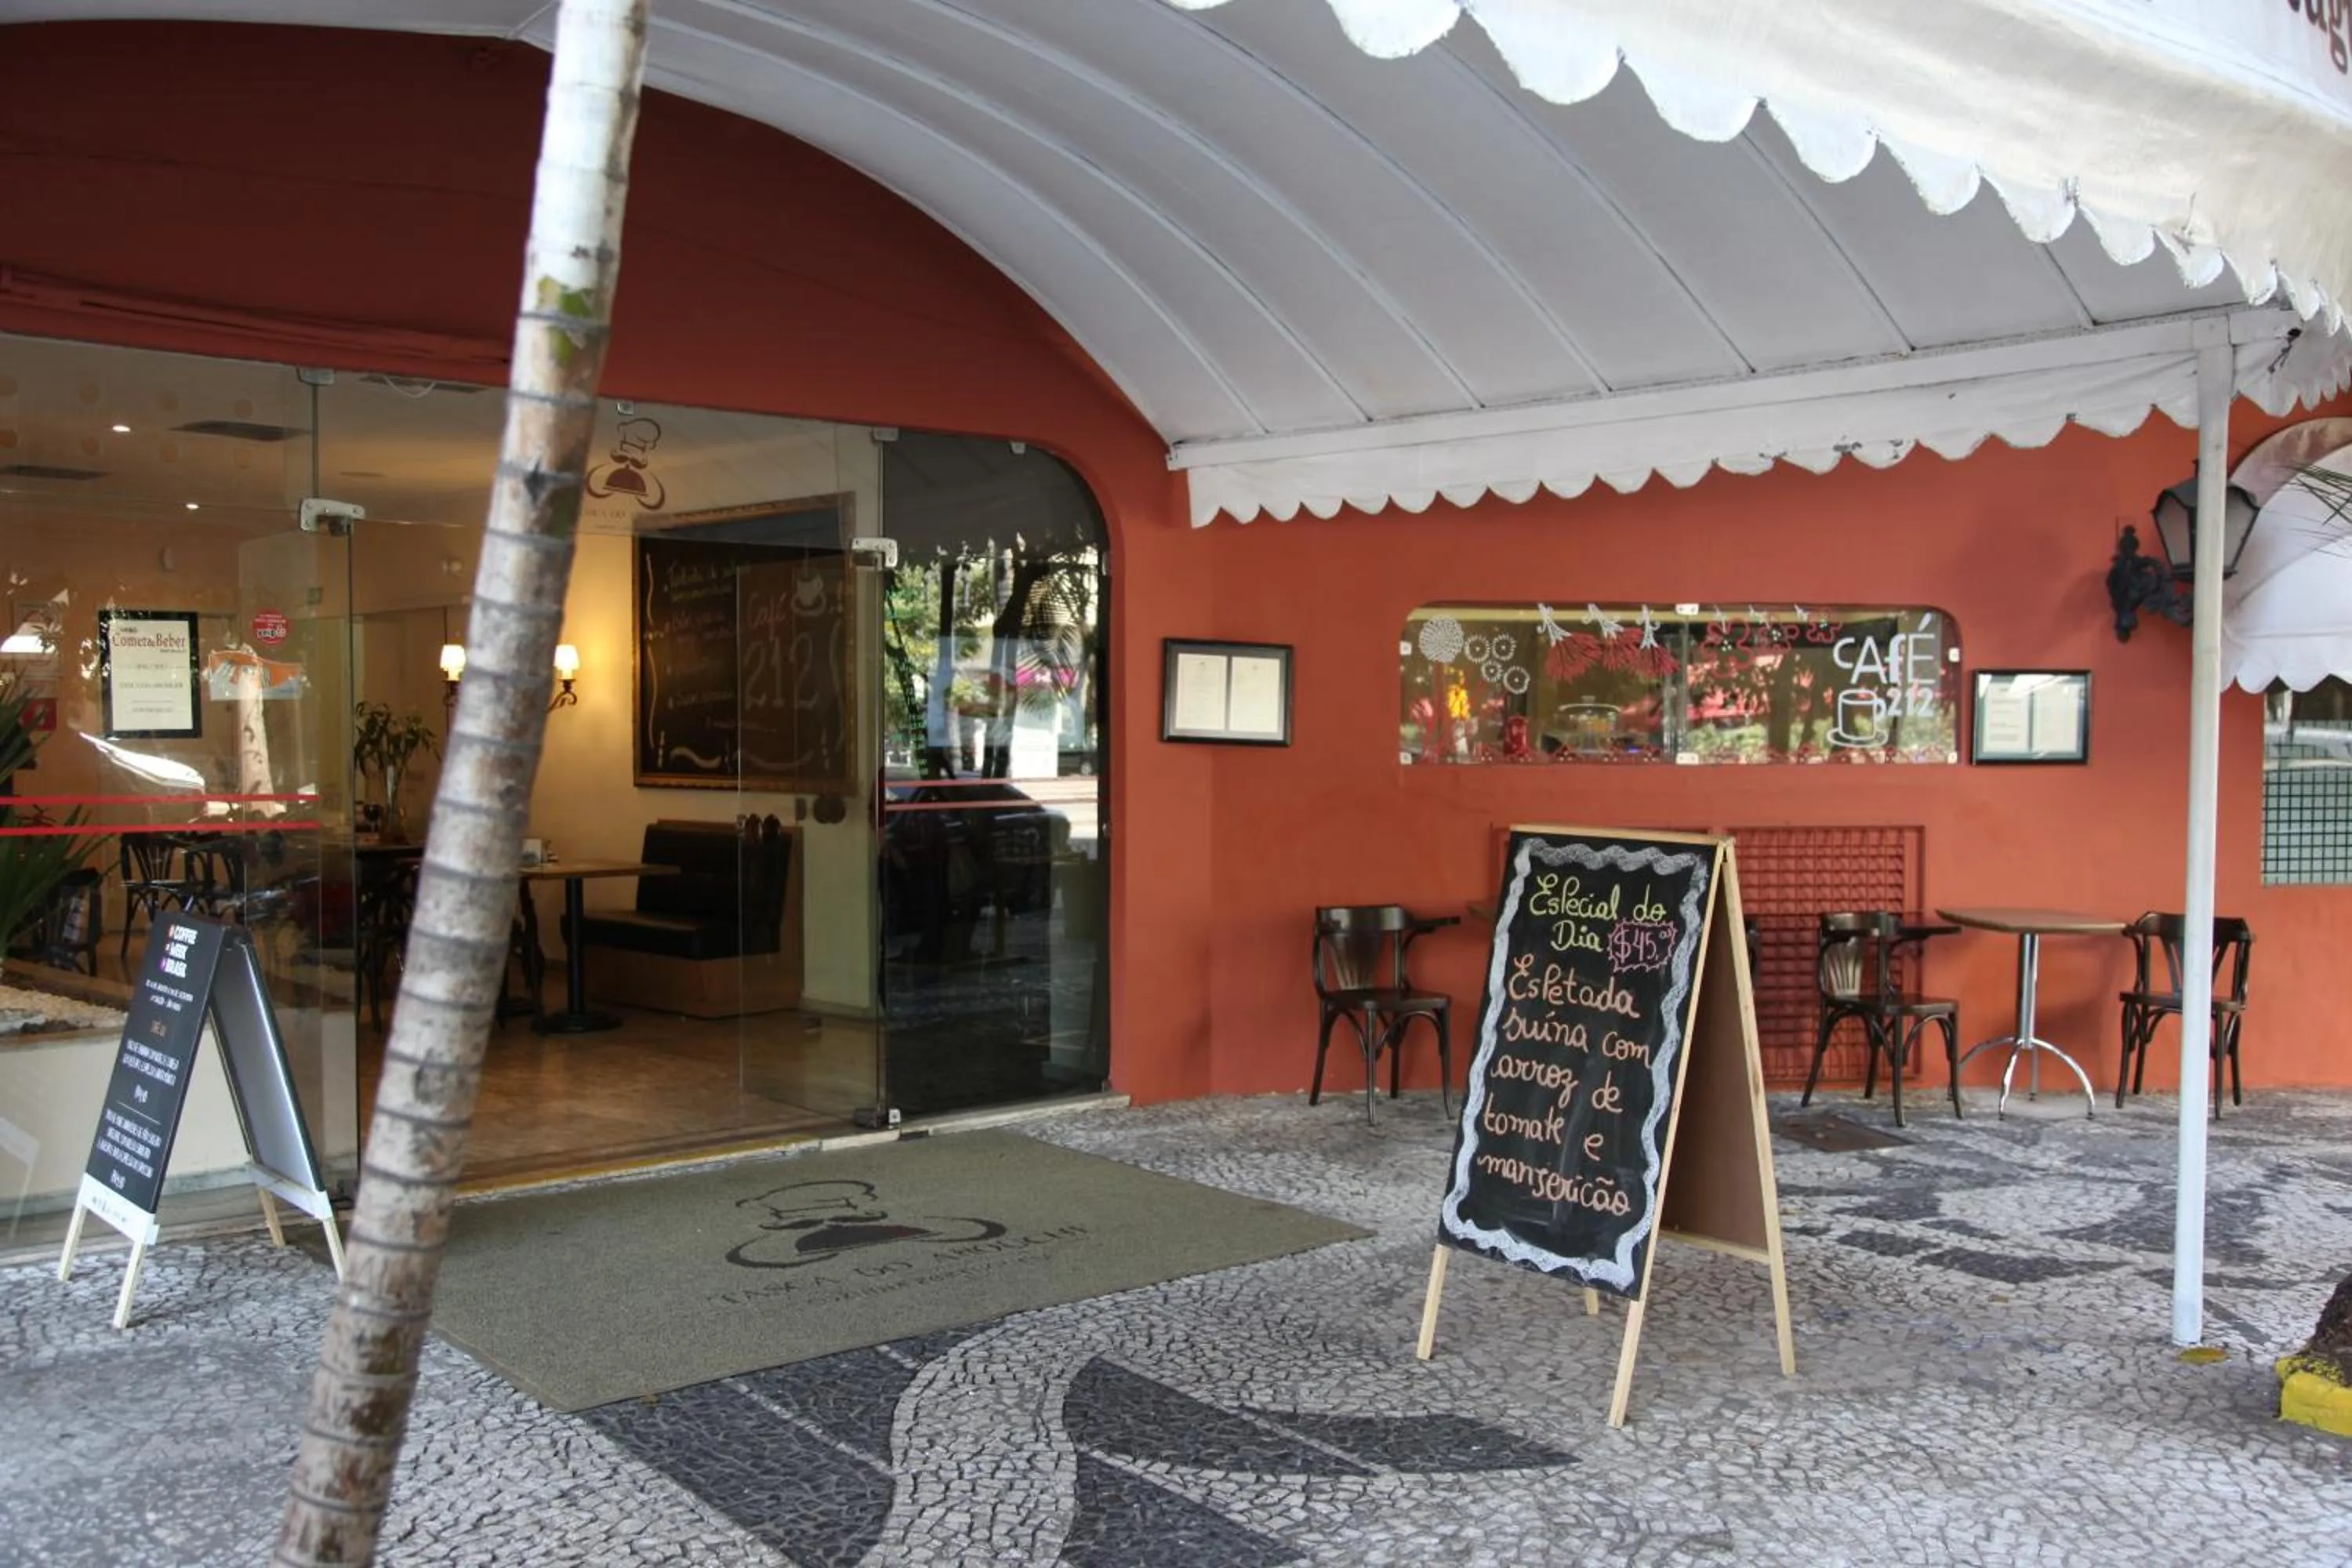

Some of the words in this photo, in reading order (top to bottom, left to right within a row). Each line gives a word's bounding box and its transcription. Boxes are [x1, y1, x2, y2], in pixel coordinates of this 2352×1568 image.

[744, 637, 820, 710] 212
[1886, 688, 1934, 717] 212
[1530, 873, 1621, 920] Especial
[1633, 883, 1667, 921] do
[1550, 920, 1603, 953] Dia
[1508, 953, 1640, 1018] Espetada
[1502, 1007, 1589, 1054] suína
[1602, 1031, 1653, 1069] com
[1490, 1054, 1579, 1109] arroz
[1592, 1071, 1623, 1113] de
[1484, 1092, 1564, 1145] tomate
[1584, 1133, 1604, 1161] e
[1477, 1155, 1632, 1215] manjericão
